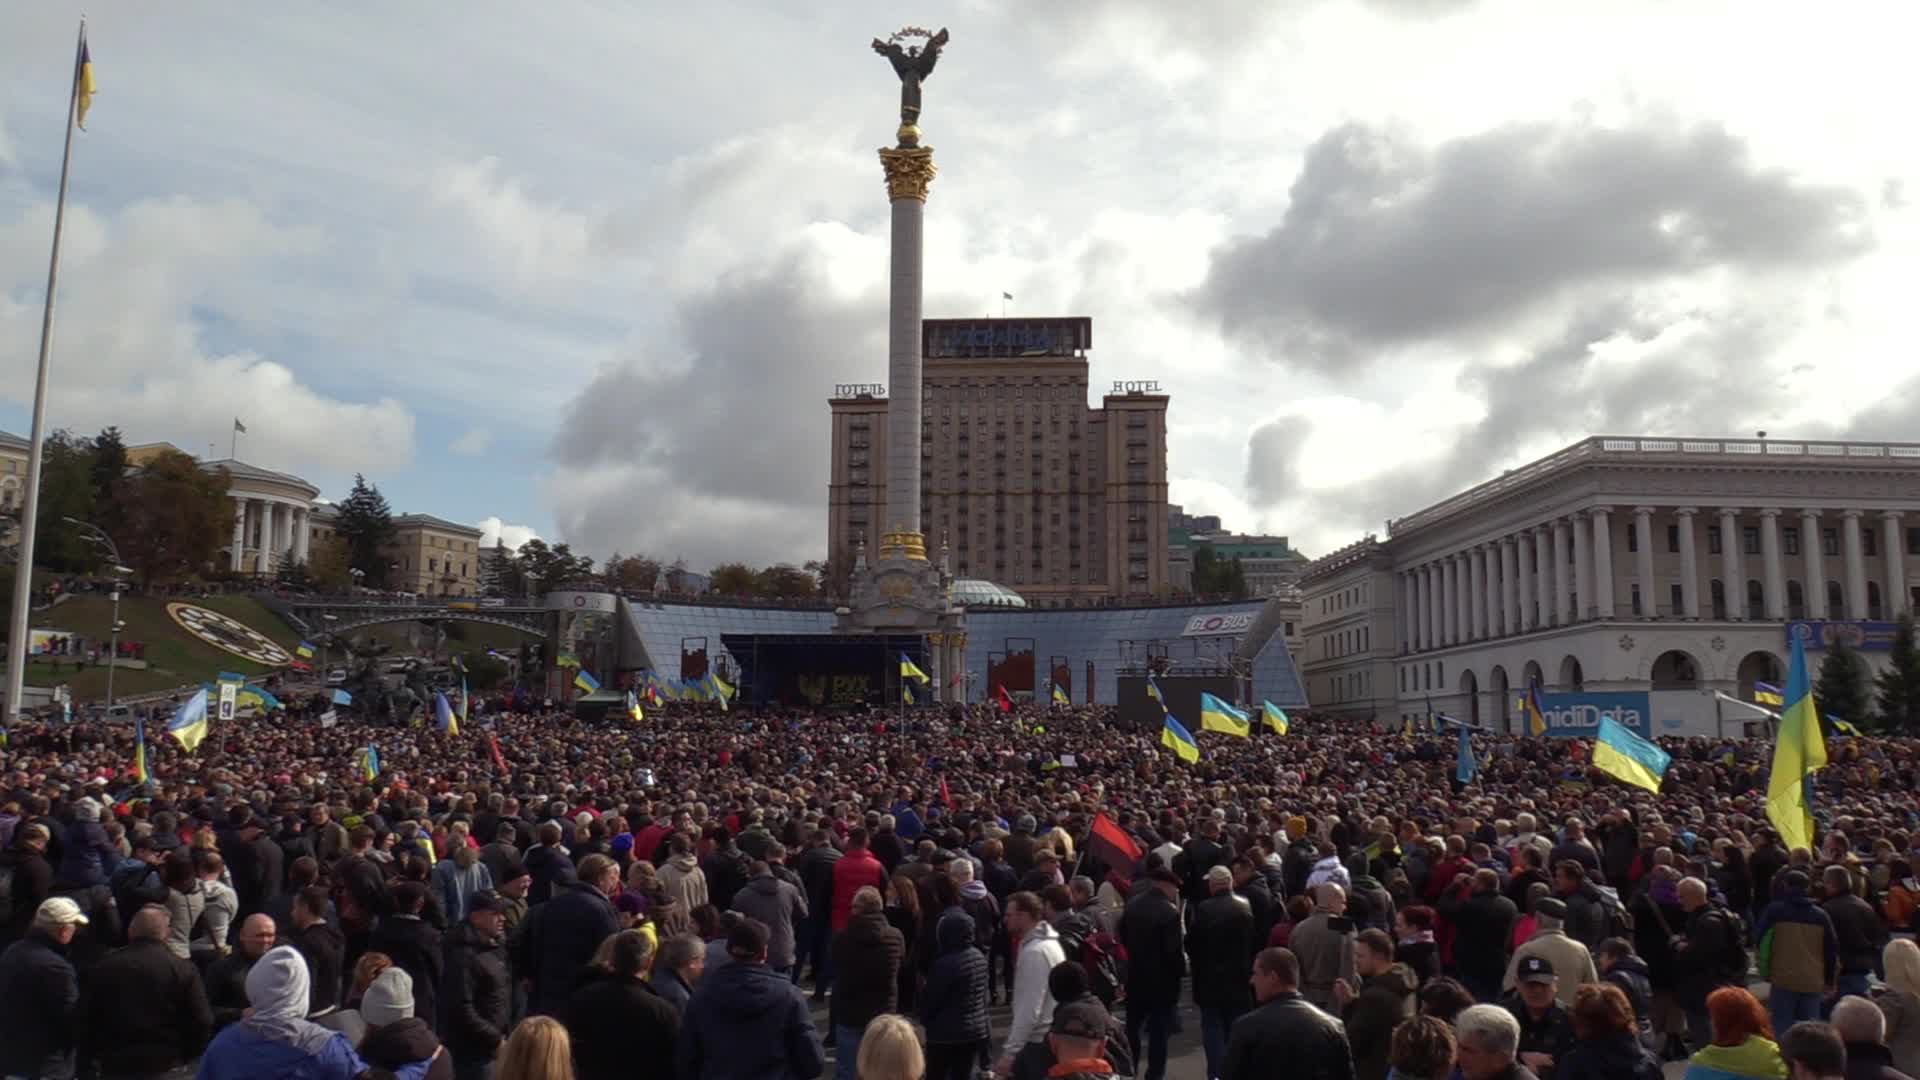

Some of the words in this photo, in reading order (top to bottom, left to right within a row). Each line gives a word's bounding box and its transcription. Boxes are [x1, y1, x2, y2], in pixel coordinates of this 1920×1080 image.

[835, 384, 886, 396] ГОТЕЛЬ
[1112, 380, 1162, 393] HOTEL
[1191, 615, 1249, 632] GLOBUS
